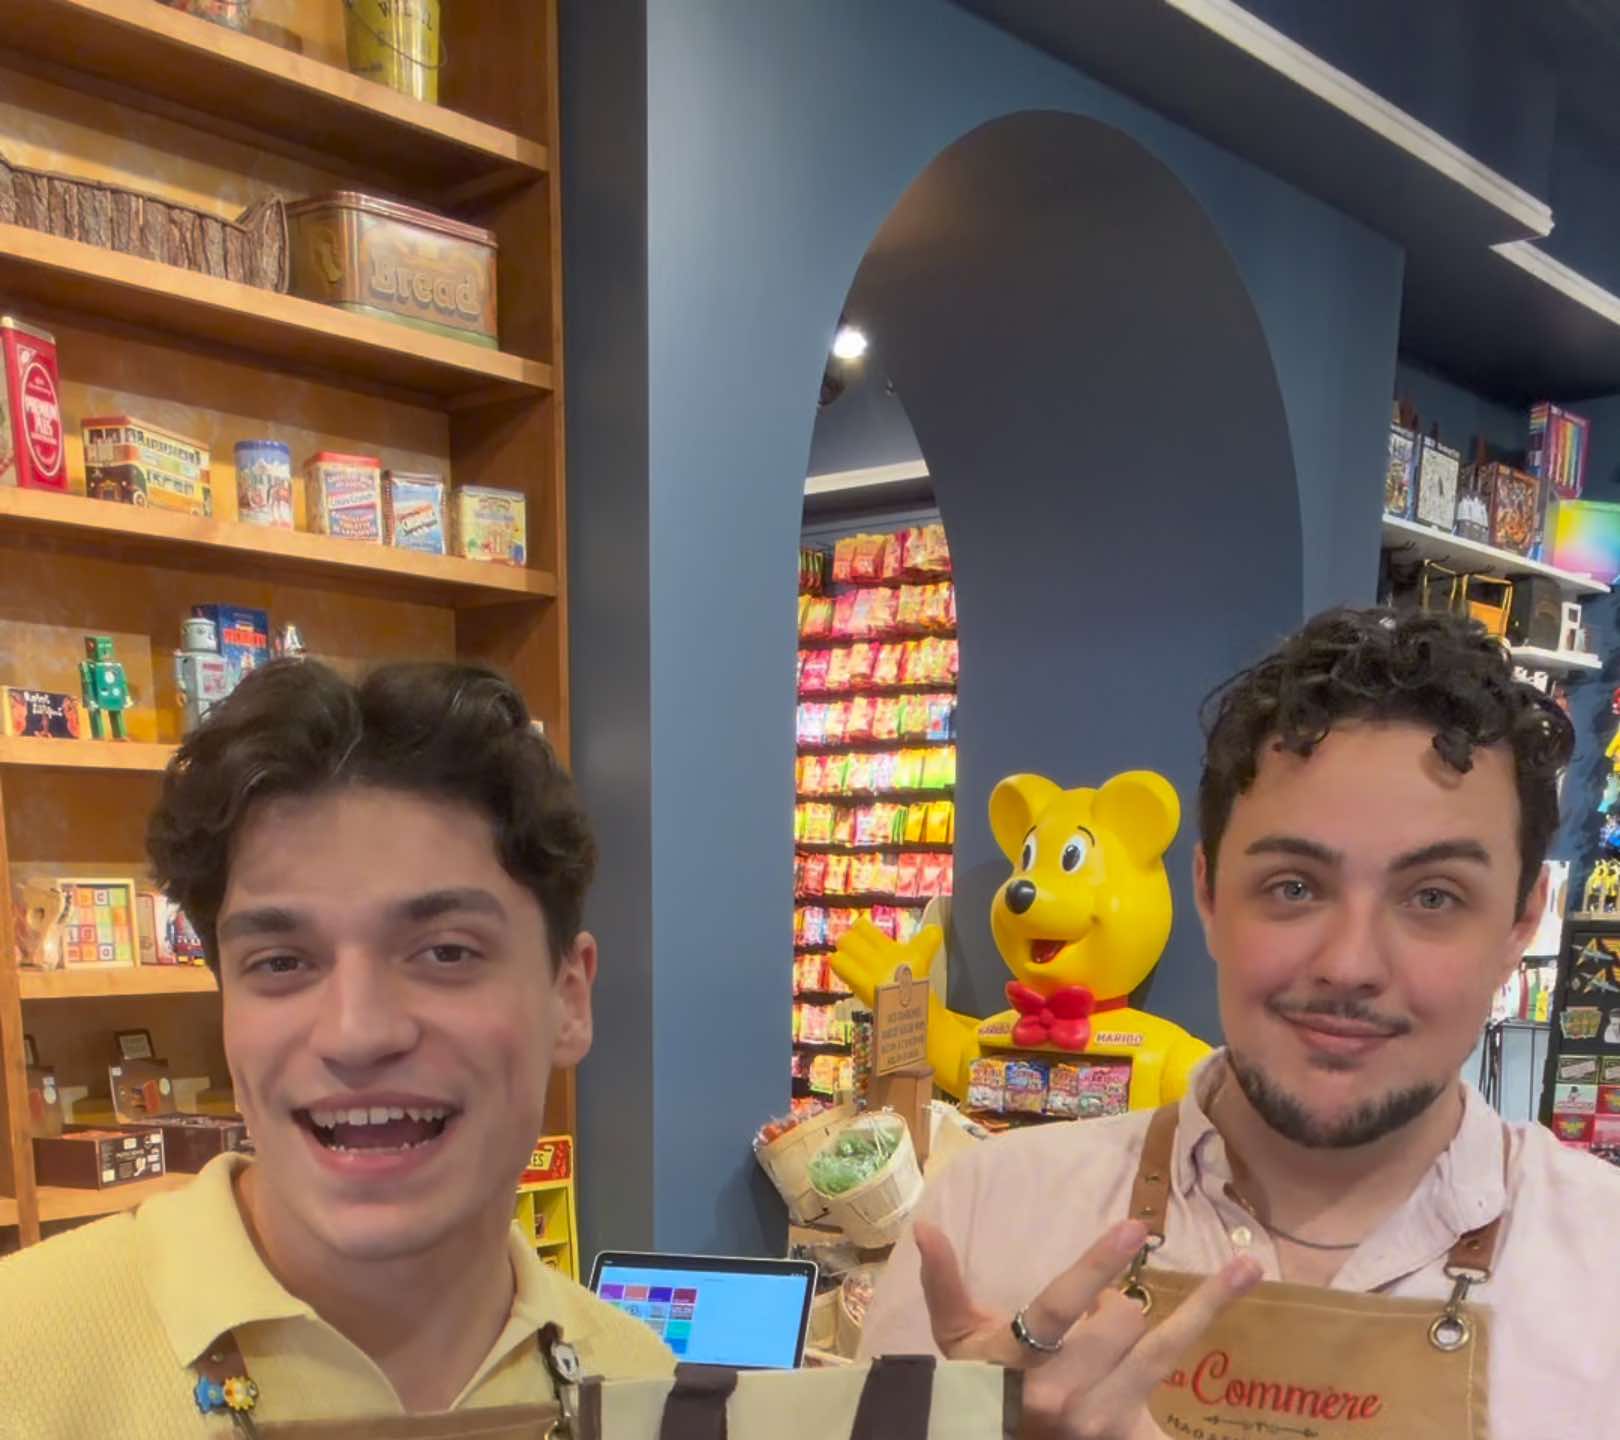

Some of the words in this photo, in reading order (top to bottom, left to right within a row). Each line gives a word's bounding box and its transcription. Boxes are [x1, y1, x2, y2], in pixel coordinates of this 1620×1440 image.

[370, 249, 483, 322] Bread
[532, 1152, 545, 1168] ES
[1161, 1369, 1189, 1388] a
[1191, 1349, 1385, 1421] Commère
